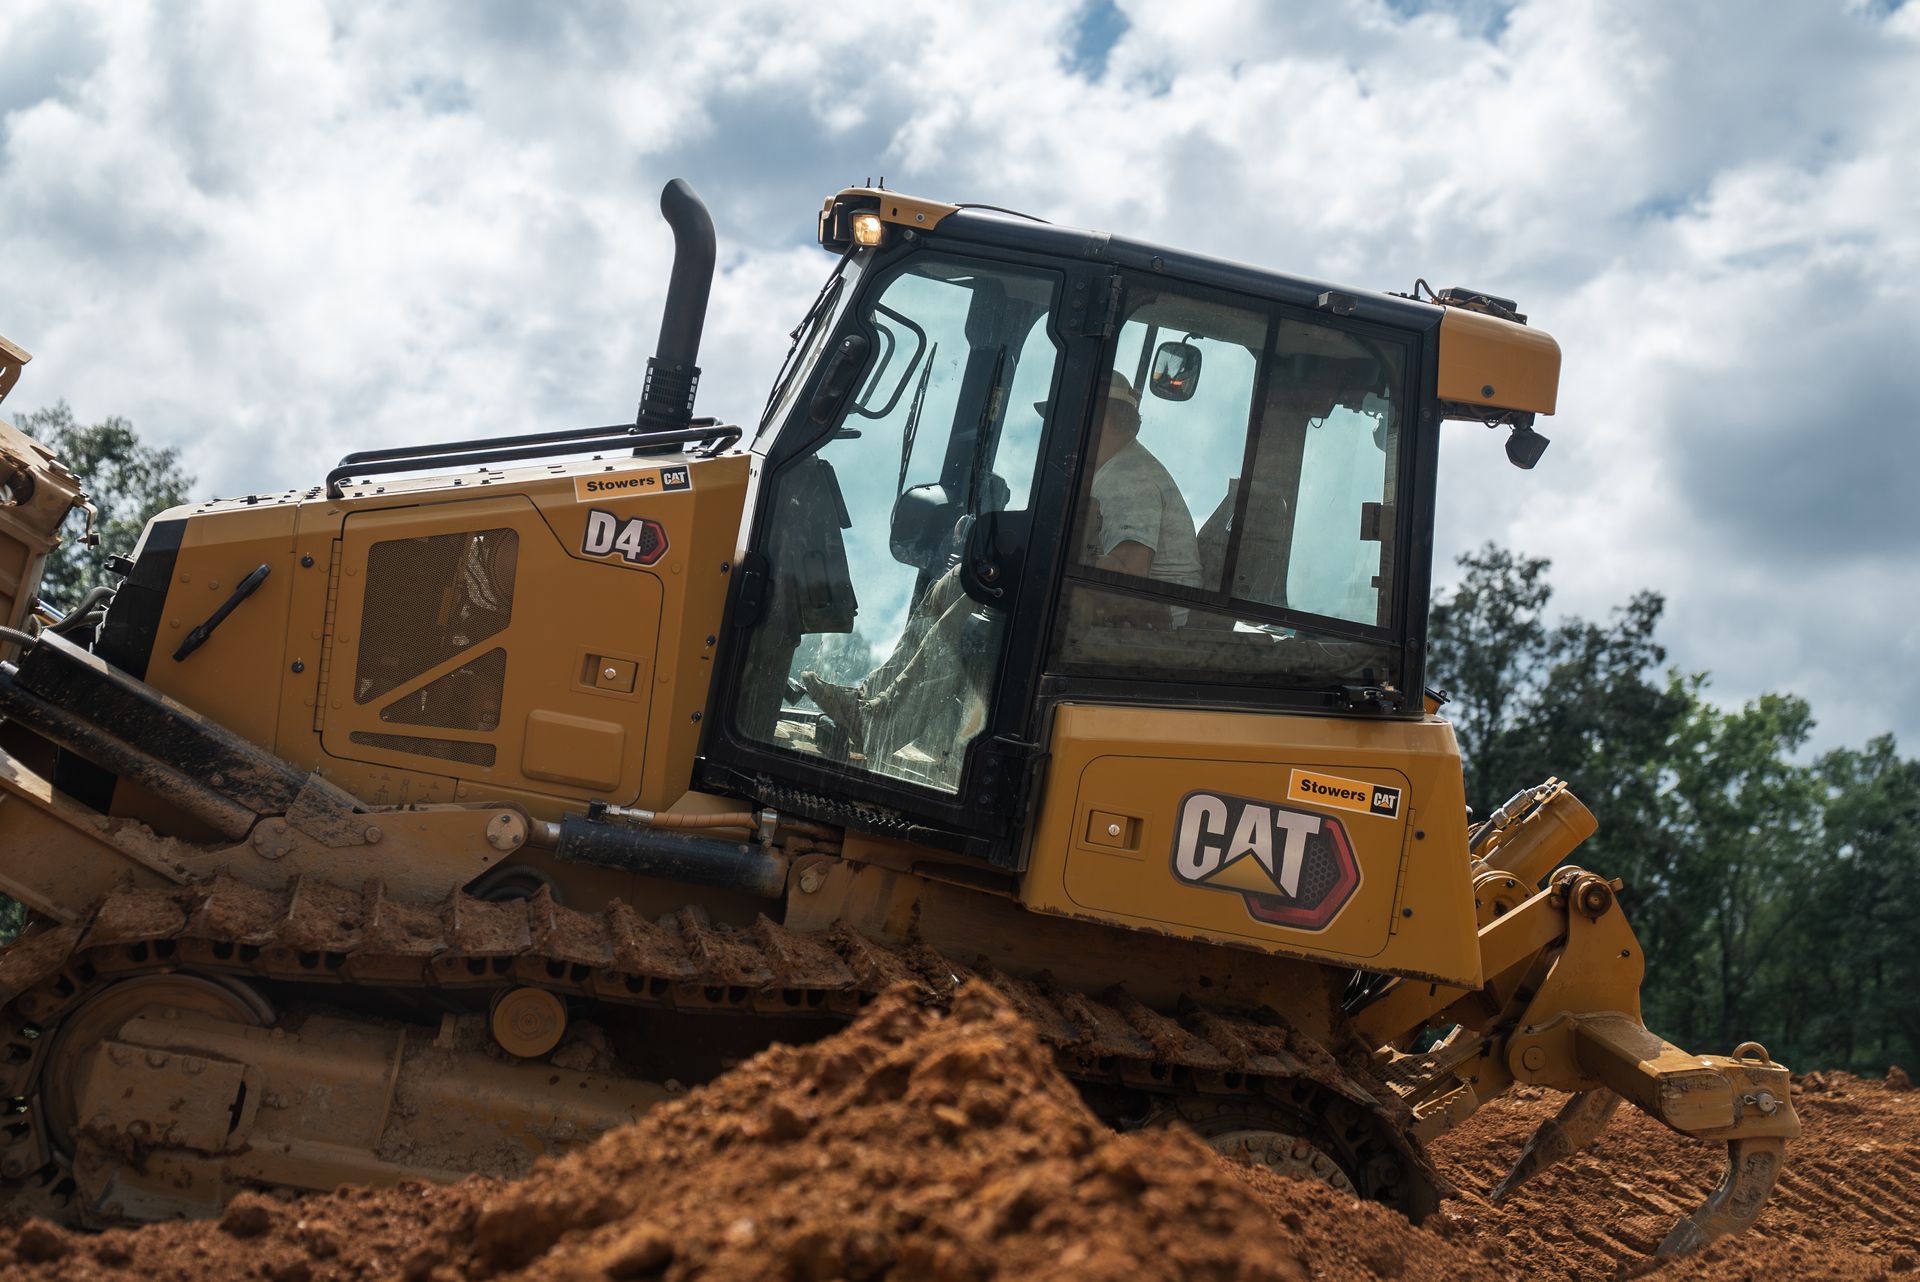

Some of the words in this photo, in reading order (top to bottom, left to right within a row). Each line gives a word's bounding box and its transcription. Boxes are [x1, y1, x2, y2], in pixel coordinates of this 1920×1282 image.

[587, 477, 655, 492] Stowers
[664, 472, 686, 485] CAT
[585, 511, 643, 559] D4
[1300, 779, 1365, 802] Stowers
[1373, 792, 1396, 808] CAT
[1176, 795, 1321, 898] CAT
